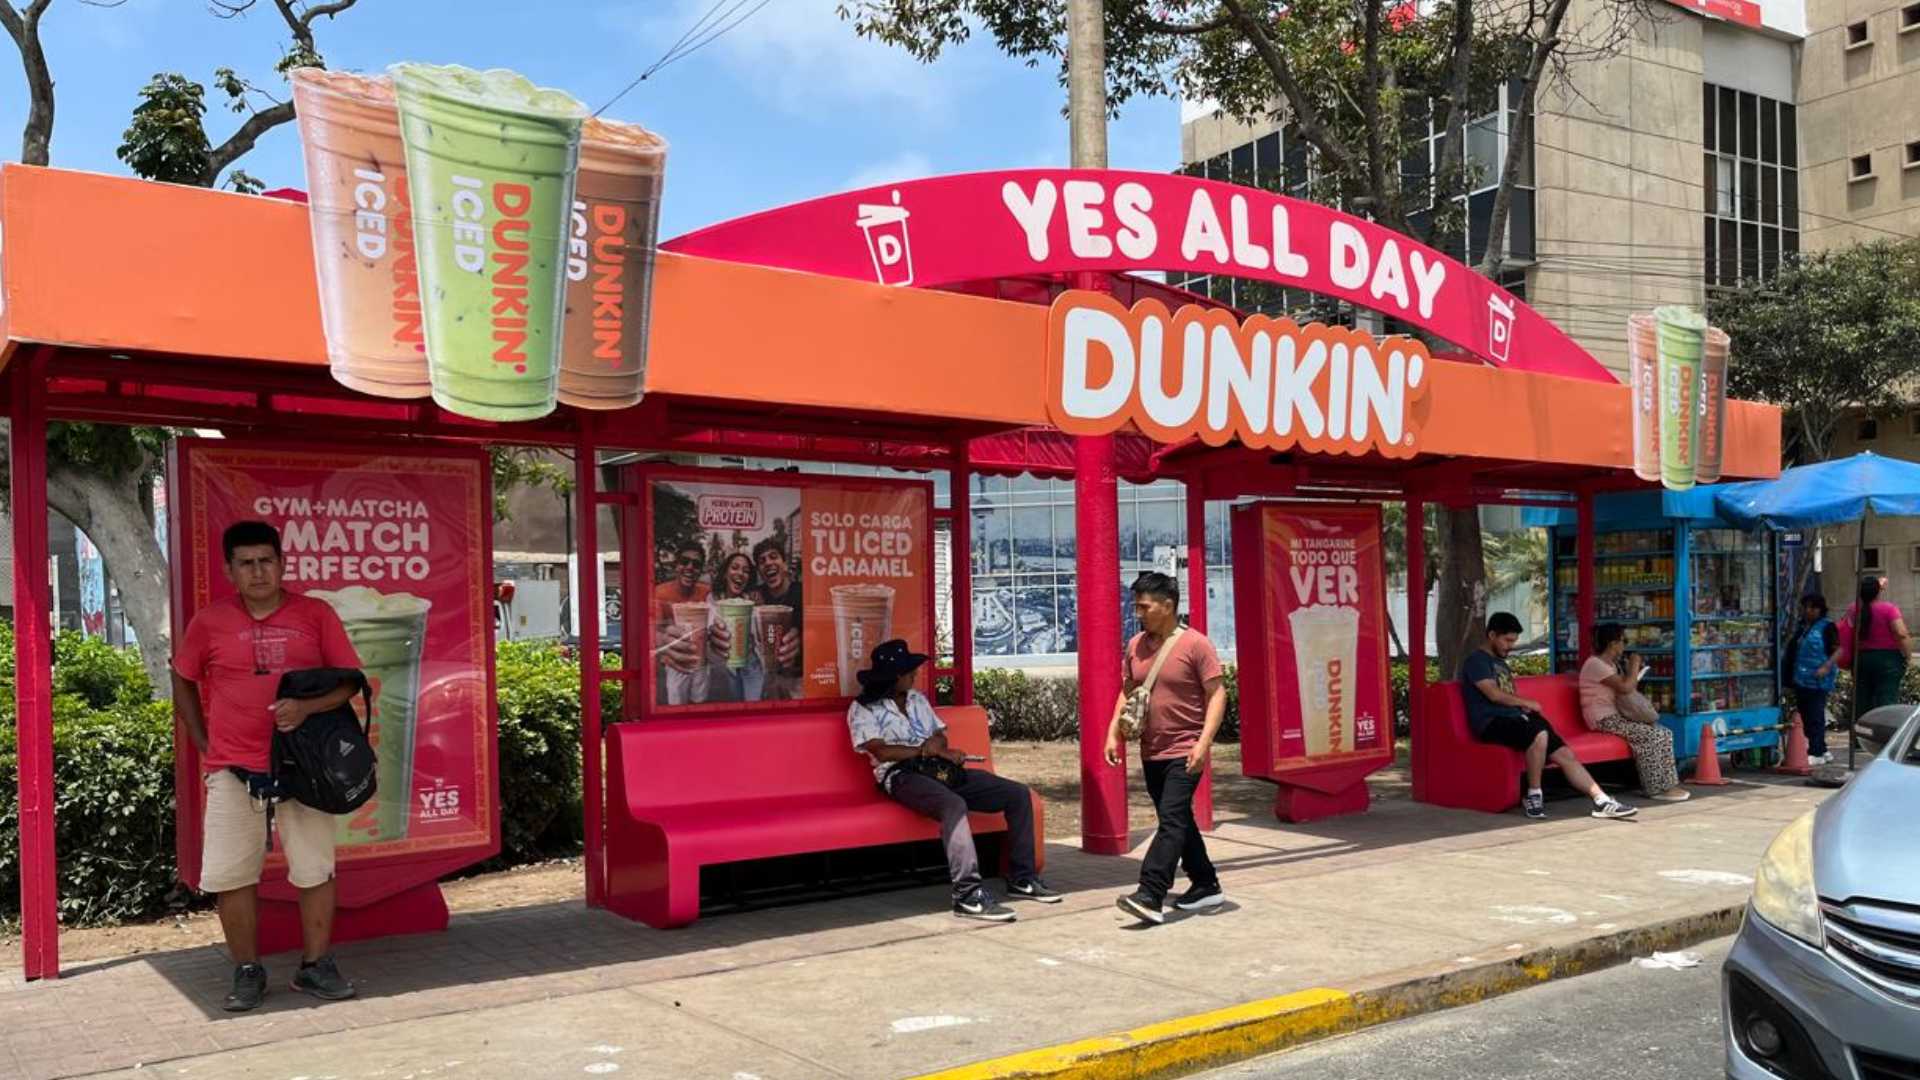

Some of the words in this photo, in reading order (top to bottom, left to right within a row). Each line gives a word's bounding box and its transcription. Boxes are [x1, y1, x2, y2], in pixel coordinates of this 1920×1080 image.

[353, 168, 386, 259] ICED
[451, 175, 485, 273] ICED
[878, 234, 902, 266] D
[1002, 178, 1158, 262] YES
[1181, 188, 1309, 278] ALL
[1330, 221, 1446, 319] DAY
[491, 182, 532, 375] DUNKIN'
[592, 205, 626, 369] DUNKIN'
[1062, 306, 1424, 445] DUNKIN'
[254, 496, 429, 519] GYM+MATCHA
[702, 507, 757, 527] PROTEIN
[811, 512, 855, 527] SOLO
[859, 514, 913, 529] CARGA
[811, 528, 847, 554] TU
[853, 529, 913, 556] ICED
[281, 555, 431, 581] ERFECTO
[811, 556, 914, 577] CARAMEL
[1290, 551, 1328, 566] TODO
[1331, 551, 1358, 566] QUE
[1289, 565, 1360, 604] VER
[419, 790, 460, 809] YES
[420, 809, 438, 818] ALL
[440, 806, 460, 816] DAY
